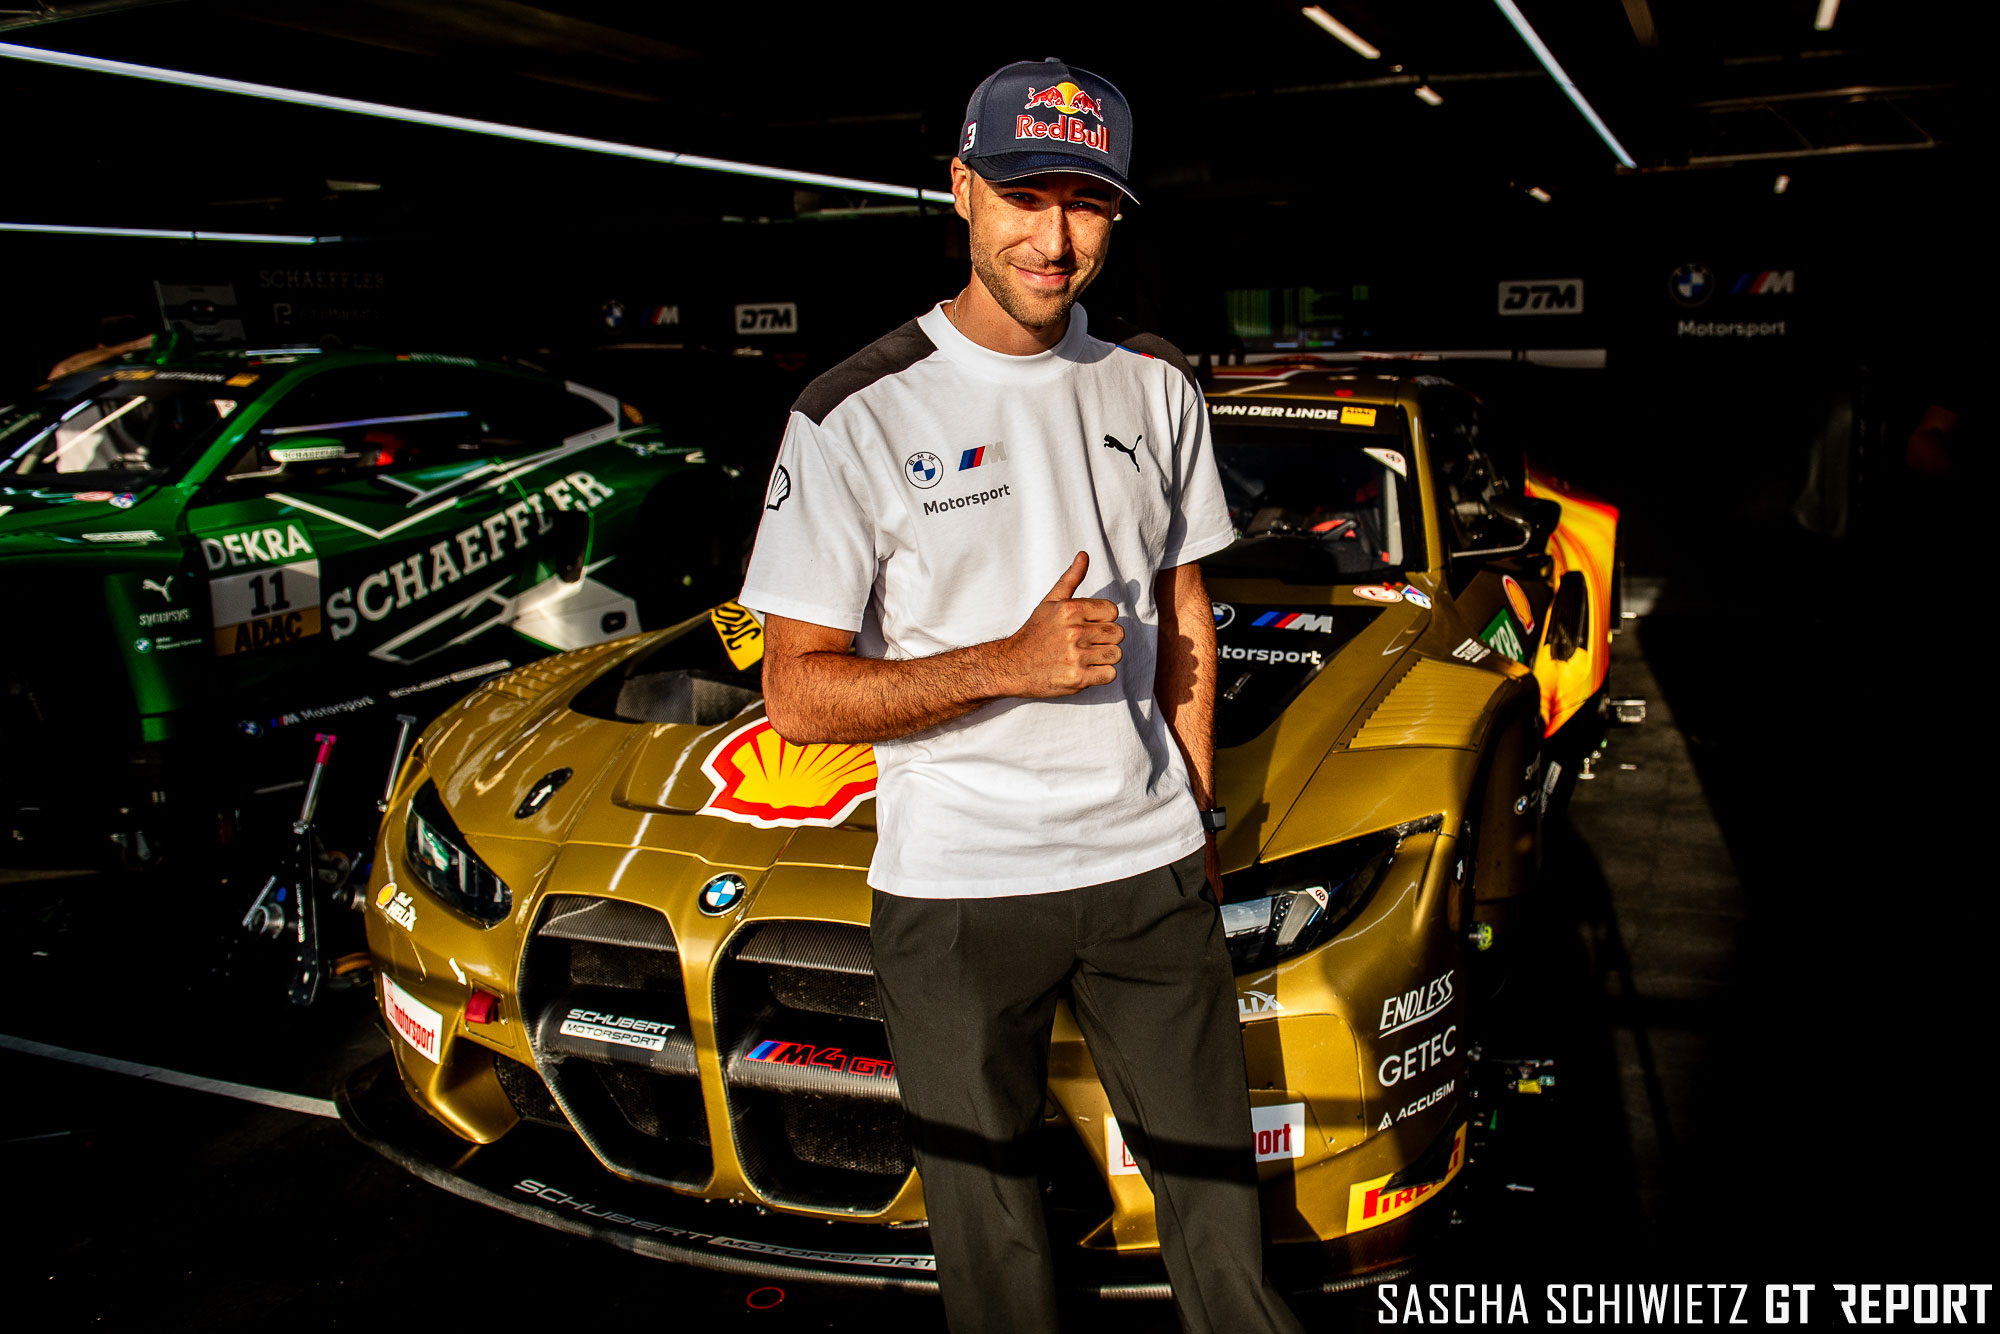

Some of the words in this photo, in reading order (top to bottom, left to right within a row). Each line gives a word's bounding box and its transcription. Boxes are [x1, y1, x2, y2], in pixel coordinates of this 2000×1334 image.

[962, 120, 977, 154] 3
[1015, 114, 1067, 142] Red
[1067, 117, 1109, 153] Bull
[1504, 286, 1575, 309] DTM
[741, 308, 791, 329] DTM
[1676, 319, 1787, 337] Motorsport
[1211, 404, 1252, 416] VAN
[1252, 406, 1284, 417] DER
[1284, 407, 1339, 420] LINDE
[923, 484, 1011, 516] Motorsport
[200, 524, 315, 571] DEKRA
[325, 470, 615, 642] SCHAEFFLER
[249, 571, 290, 616] 11
[235, 612, 303, 651] ADAC
[715, 606, 761, 651] DAC
[1217, 644, 1322, 665] torsport
[301, 695, 376, 721] Motorsport
[1238, 990, 1284, 1014] LIX
[1379, 969, 1455, 1031] ENDLESS
[394, 1003, 435, 1054] motorsport
[565, 1023, 661, 1047] MOTORSPORT
[566, 1007, 677, 1035] SCHUBERT
[773, 1043, 848, 1073] M4
[1378, 1024, 1457, 1087] GETEC
[1396, 1079, 1456, 1122] ACCUSIM
[512, 1178, 715, 1242] SCHUBERT
[723, 1237, 934, 1268] MOTORSPORT
